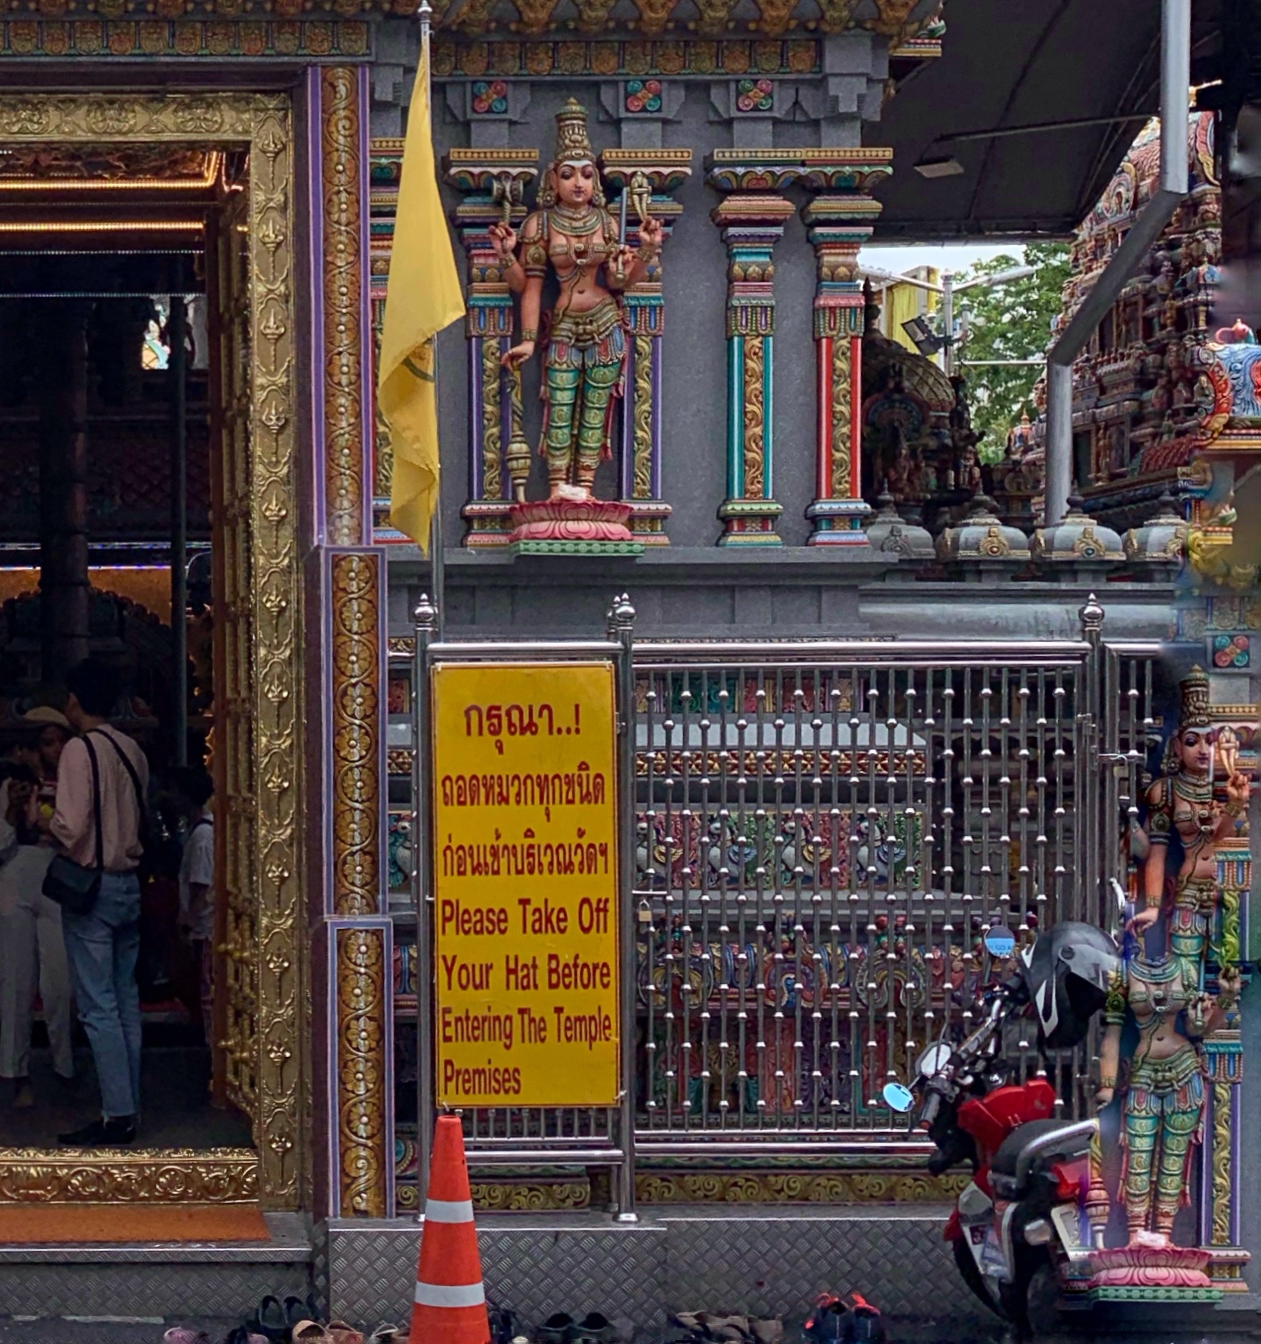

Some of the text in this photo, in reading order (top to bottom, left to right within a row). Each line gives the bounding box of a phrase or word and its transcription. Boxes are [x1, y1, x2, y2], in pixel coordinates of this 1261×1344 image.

[463, 703, 581, 756] กรุณา..!
[441, 760, 605, 823] ถอดหมวกทุกชนิด
[442, 826, 609, 877] ก่อนเข้าบริเวณวัดฯ
[441, 896, 610, 936] Please Take Off
[441, 953, 611, 991] Your Hat Before
[441, 1004, 612, 1051] Entering The Temple
[443, 1058, 522, 1096] Premises
